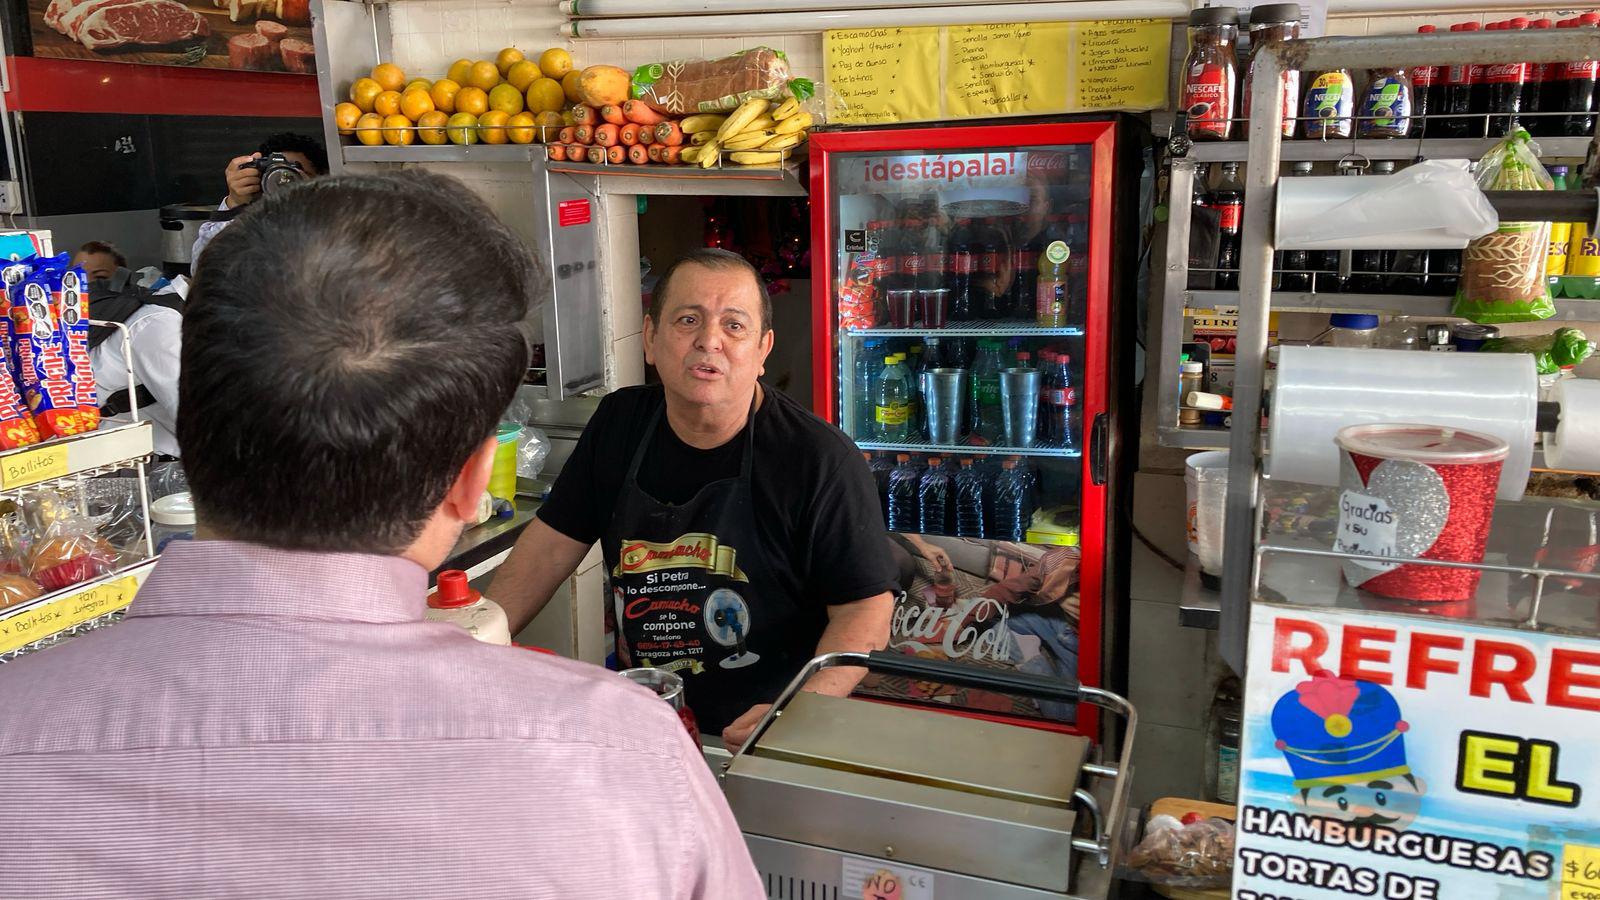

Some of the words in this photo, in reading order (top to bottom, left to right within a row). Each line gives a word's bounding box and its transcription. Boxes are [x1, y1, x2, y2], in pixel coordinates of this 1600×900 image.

[864, 151, 1016, 182] ¡destápala!
[9, 455, 54, 479] Bollitos
[1341, 494, 1393, 524] Gracias
[622, 541, 713, 571] Camacho
[646, 573, 658, 584] Si
[662, 571, 689, 583] Petra
[627, 586, 637, 595] lo
[625, 597, 700, 620] Camacho
[668, 612, 677, 620] lo
[643, 621, 696, 633] compone
[636, 650, 671, 658] Zaragoza
[688, 647, 704, 655] 1217
[1459, 731, 1580, 807] EL
[1243, 808, 1553, 879] HAMBURGUESAS
[867, 875, 896, 894] NO
[1240, 851, 1377, 894] TORTAS
[1387, 873, 1438, 900] DE
